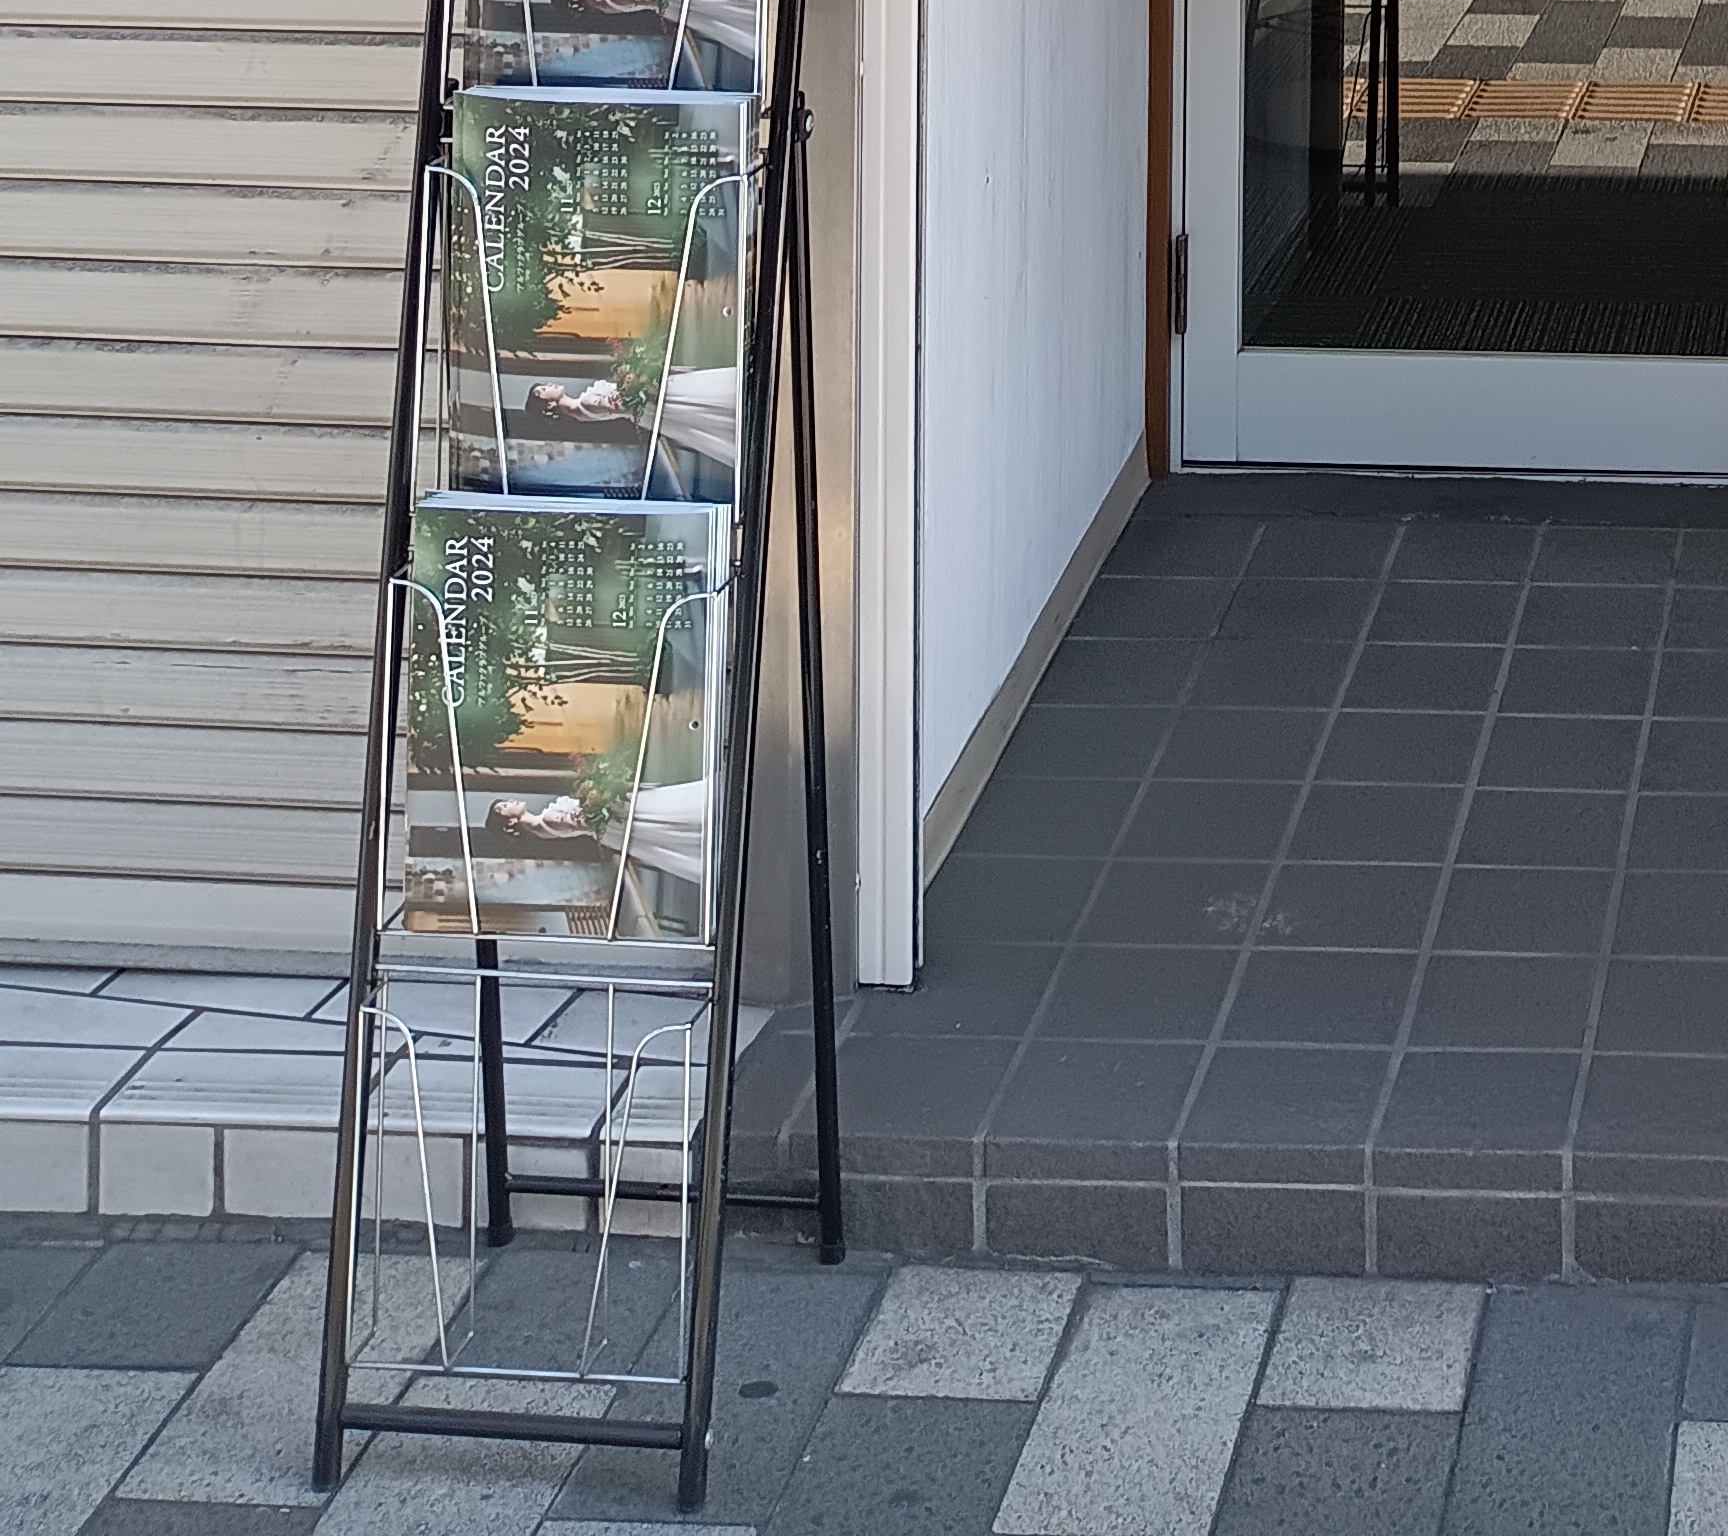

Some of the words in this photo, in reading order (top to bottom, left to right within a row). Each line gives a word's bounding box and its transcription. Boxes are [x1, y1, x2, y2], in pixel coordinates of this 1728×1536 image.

[508, 125, 530, 190] 2024
[485, 124, 508, 293] CALENDAR
[646, 198, 662, 215] 12
[470, 535, 495, 603] 2024
[442, 535, 468, 708] CALENDAR
[611, 610, 627, 628] 12
